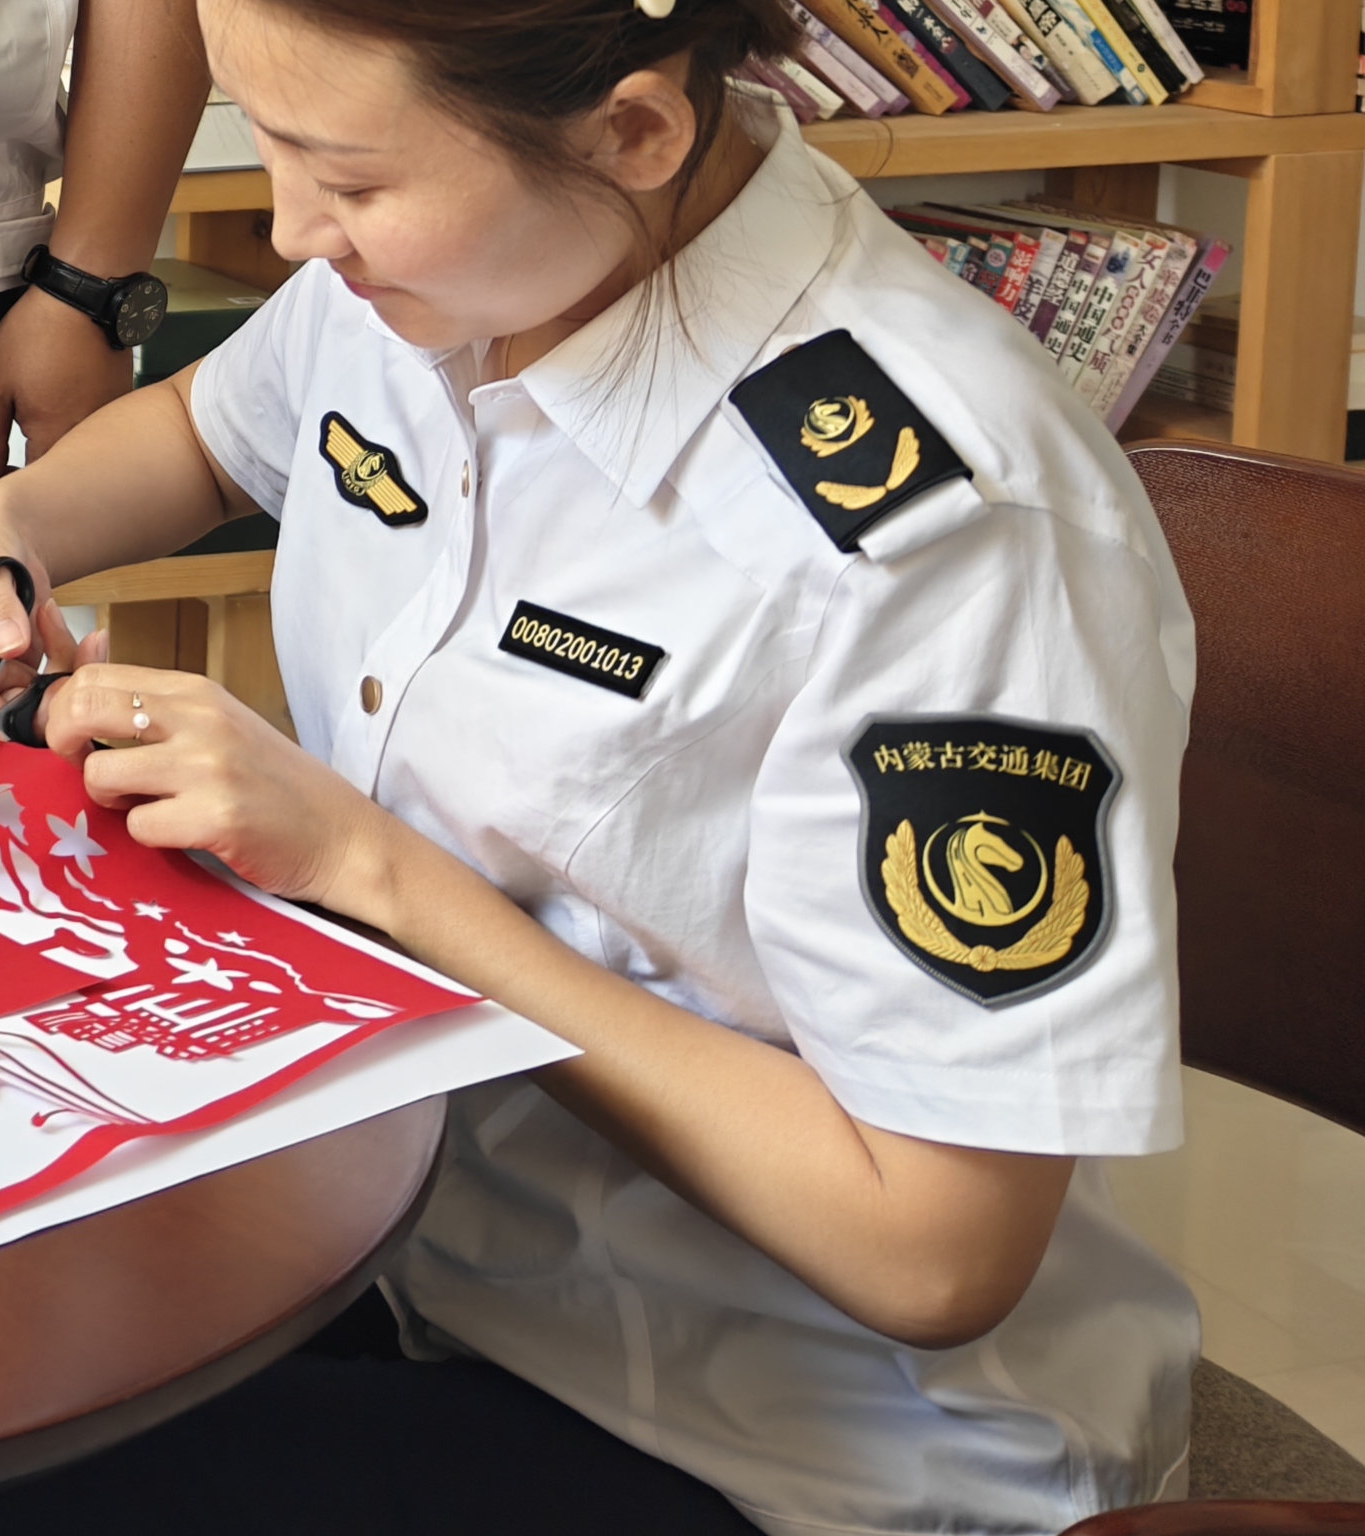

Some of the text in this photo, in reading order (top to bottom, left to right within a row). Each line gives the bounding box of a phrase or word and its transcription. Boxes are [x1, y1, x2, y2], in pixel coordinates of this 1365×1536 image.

[1046, 249, 1080, 306] 道德经
[1128, 246, 1166, 291] 女人
[1045, 276, 1091, 355] 中国通史
[1068, 284, 1114, 364] 中国通史
[511, 615, 645, 681] 00802001013
[873, 740, 1093, 792] 内蒙古交通集团
